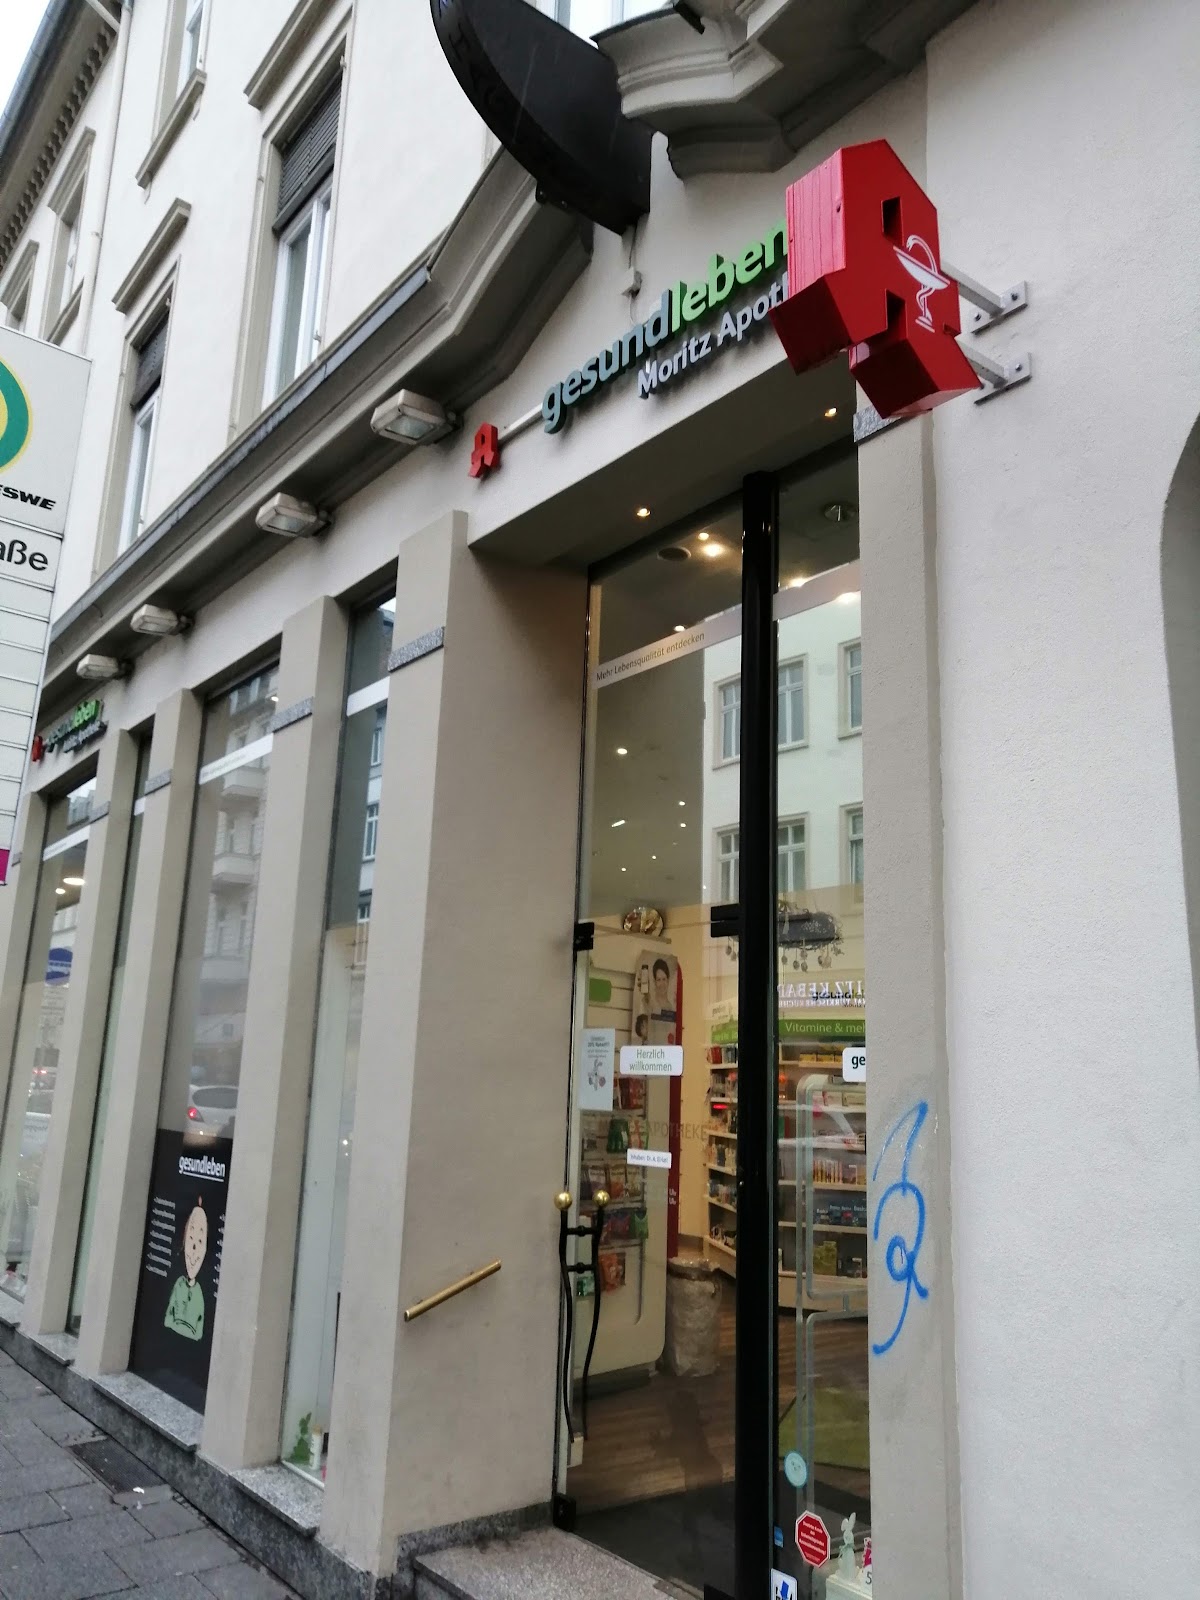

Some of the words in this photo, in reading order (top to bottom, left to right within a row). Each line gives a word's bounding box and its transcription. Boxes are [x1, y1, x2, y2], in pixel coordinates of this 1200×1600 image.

[541, 218, 788, 433] gesundleben
[637, 332, 712, 397] Moritz
[0, 484, 56, 511] SWE
[596, 668, 613, 681] Mehr
[614, 647, 665, 674] Lebensqualität
[666, 632, 705, 654] entdecken
[785, 1022, 832, 1033] Vitamine
[834, 1023, 844, 1033] &
[629, 1060, 672, 1072] willkommen
[636, 1049, 665, 1059] Herzlich
[179, 1155, 225, 1178] gesundleben
